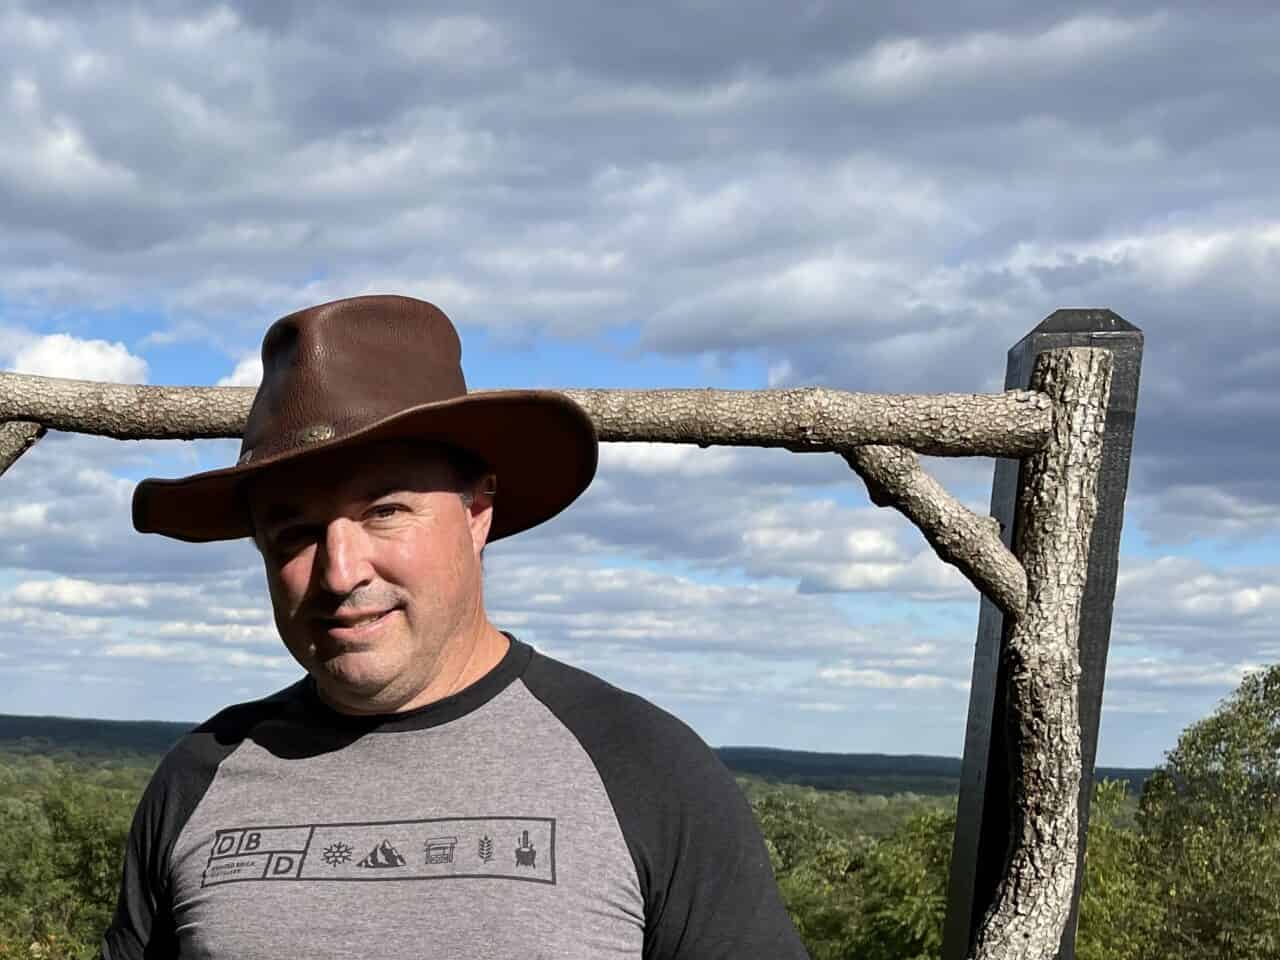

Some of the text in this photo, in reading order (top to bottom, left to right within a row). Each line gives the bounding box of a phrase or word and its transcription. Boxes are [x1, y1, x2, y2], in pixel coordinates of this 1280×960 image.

[217, 833, 261, 854] D B
[272, 856, 294, 875] D
